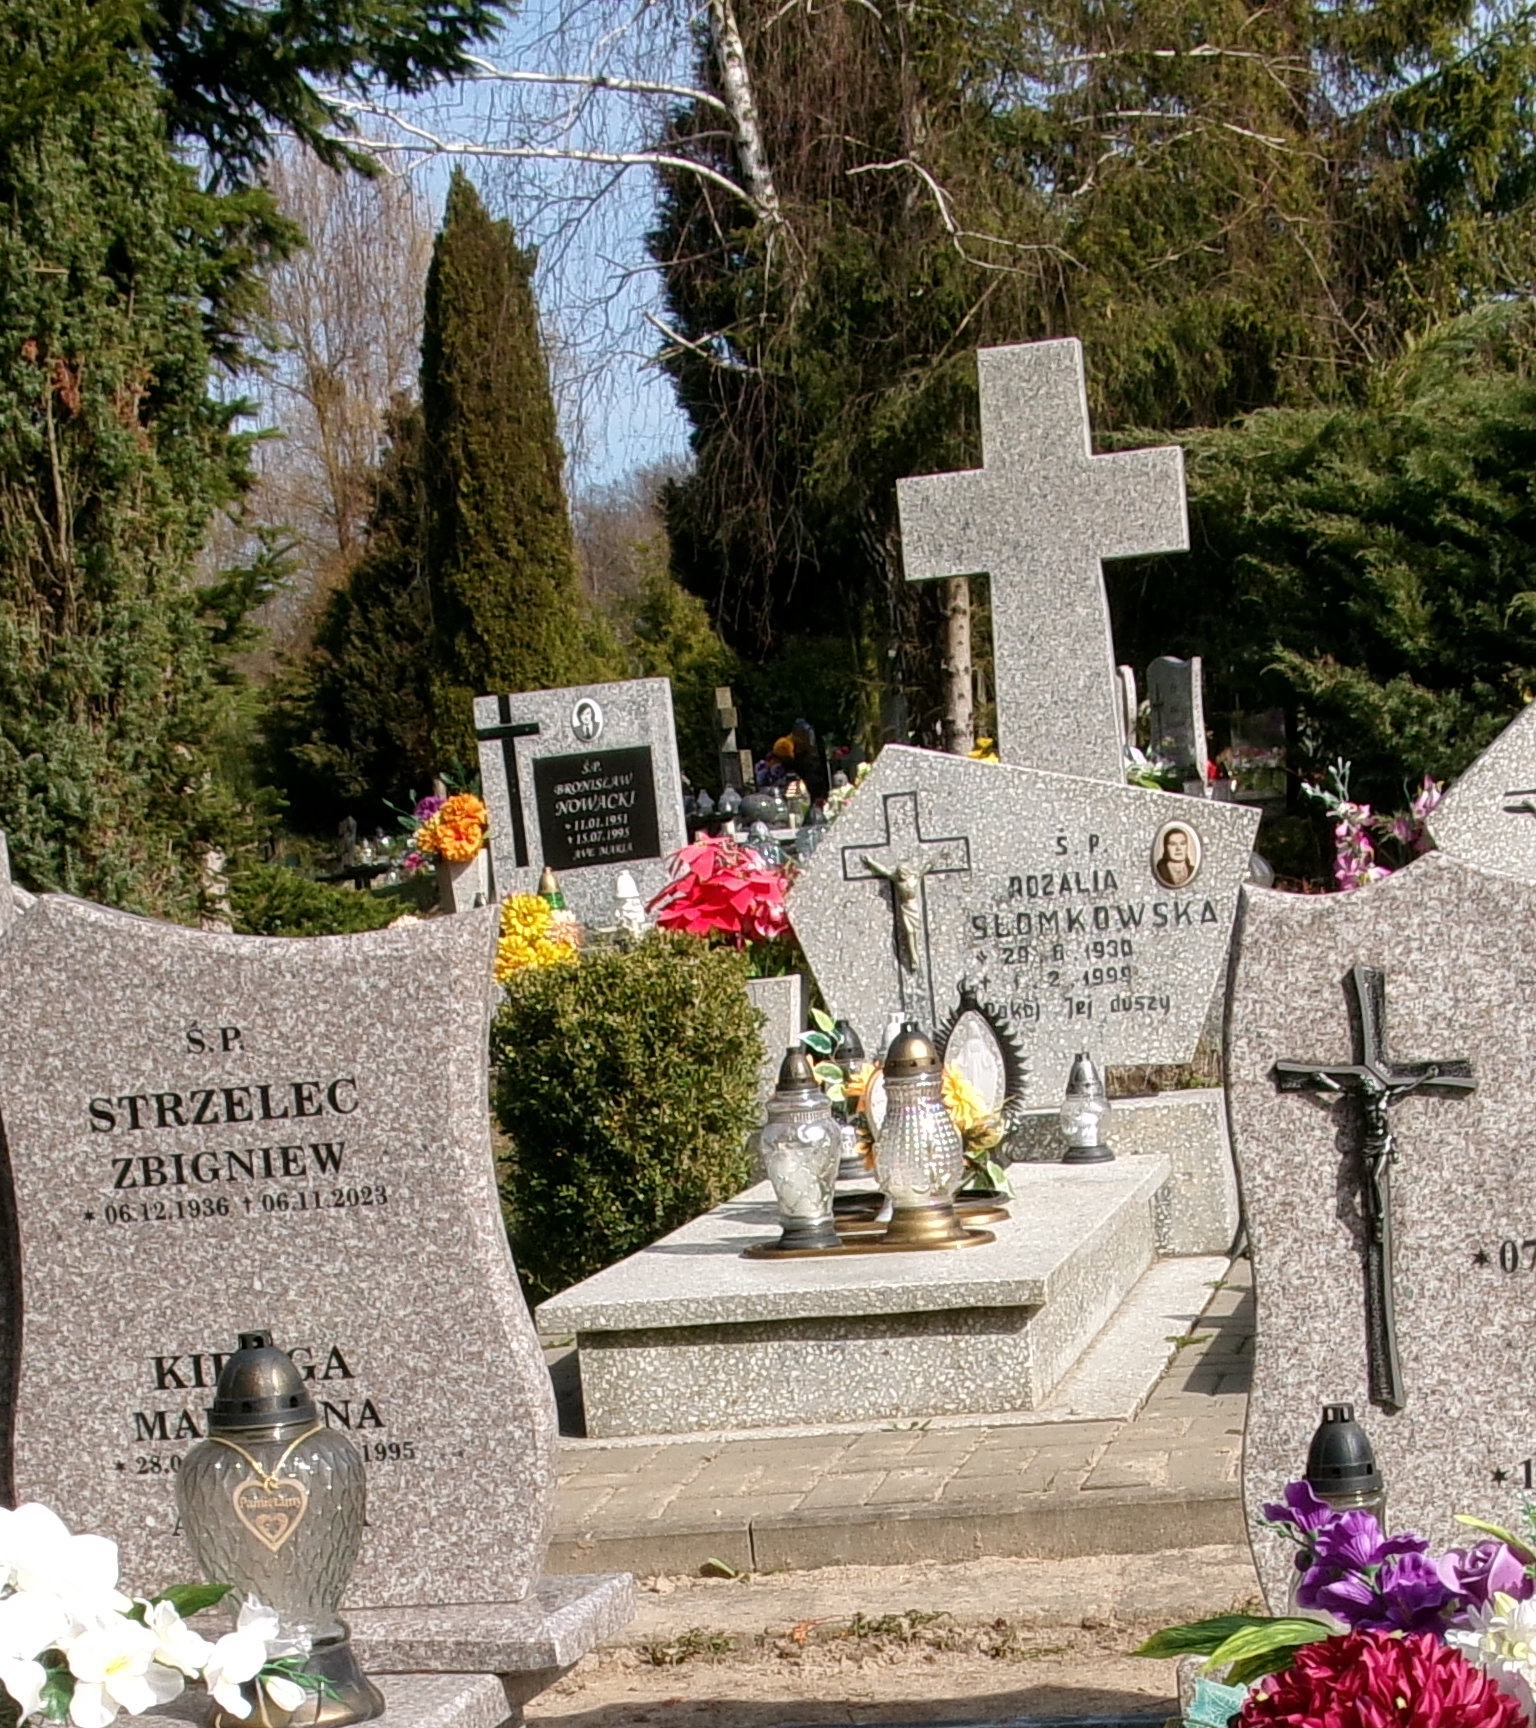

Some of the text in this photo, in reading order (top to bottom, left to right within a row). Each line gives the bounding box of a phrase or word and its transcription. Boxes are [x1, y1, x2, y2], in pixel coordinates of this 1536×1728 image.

[555, 790, 635, 816] NOWACKI
[1008, 870, 1118, 899] ROZALIA
[972, 900, 1218, 940] SŁOMKOWSKA
[1064, 995, 1093, 1019] Jej
[1110, 995, 1171, 1016] duszy
[88, 1077, 359, 1133] STRZELEC
[112, 1142, 345, 1189] ZBIGNIEW
[105, 1185, 388, 1225] 06.12.1936 06.11.2023
[150, 1345, 355, 1390] KIGA
